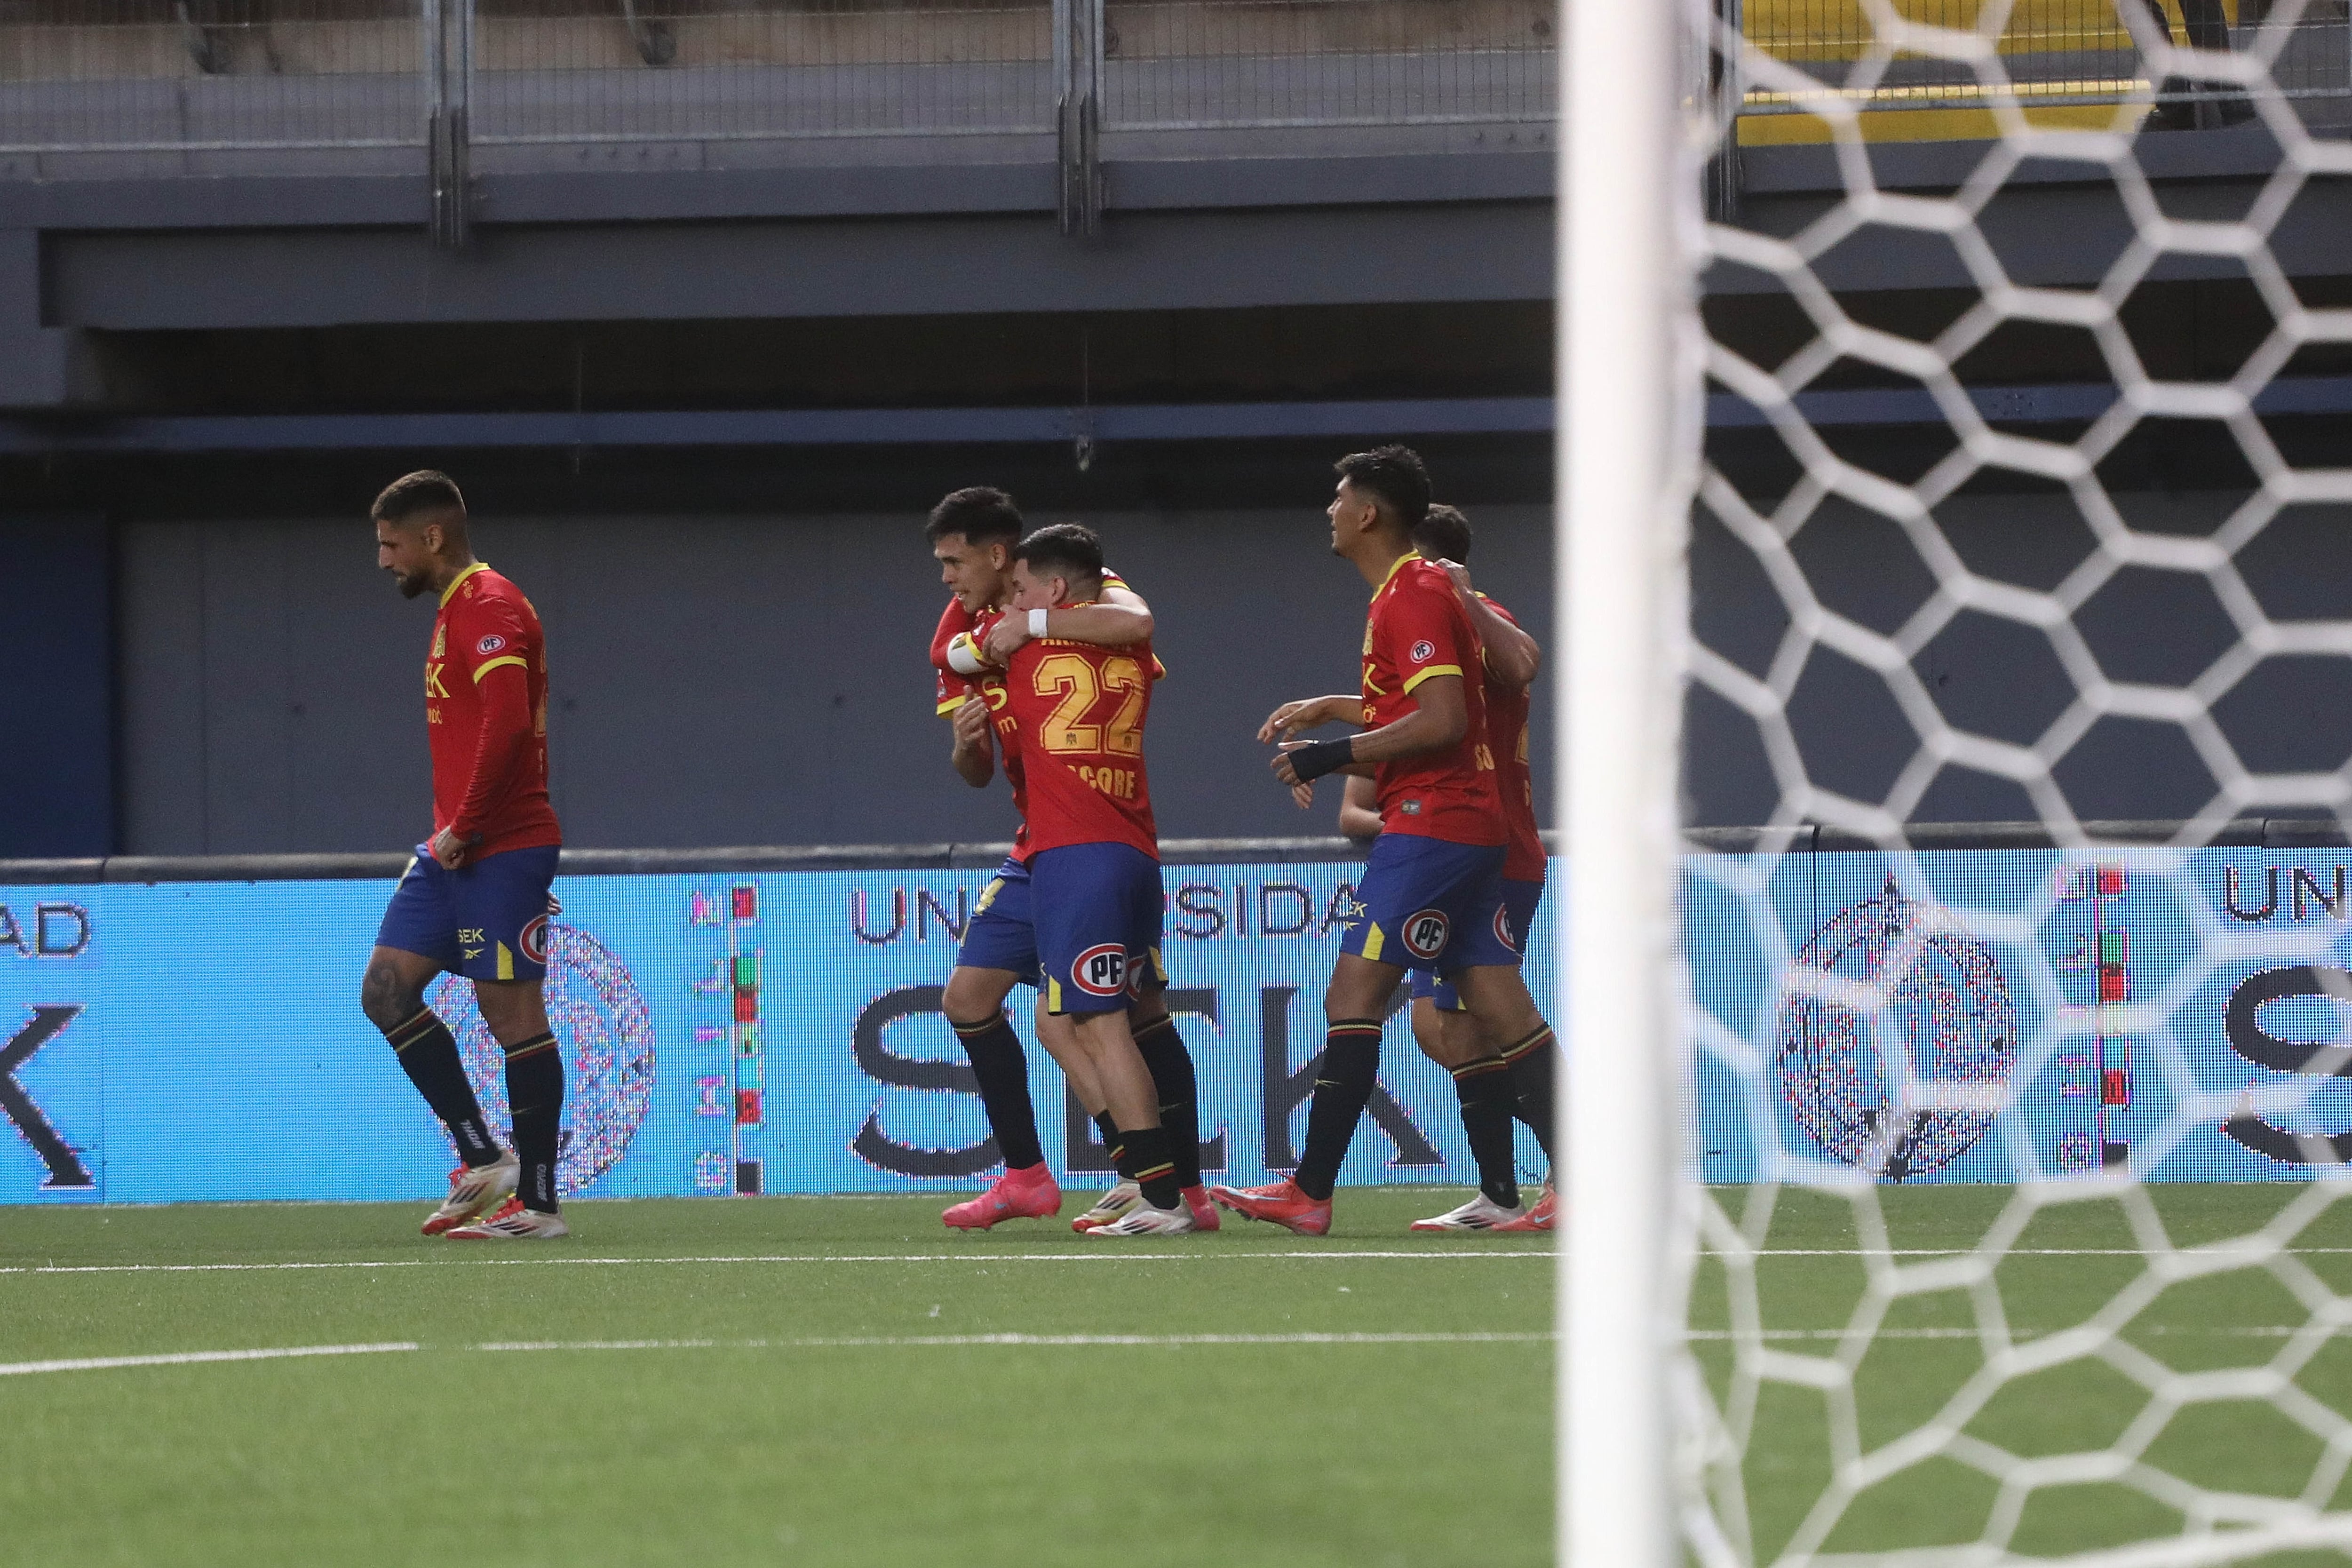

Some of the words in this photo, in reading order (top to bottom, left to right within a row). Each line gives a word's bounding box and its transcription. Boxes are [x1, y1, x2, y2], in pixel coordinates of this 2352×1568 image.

[483, 637, 497, 650] PF
[1415, 644, 1427, 658] PF
[1033, 653, 1145, 758] 22
[1414, 918, 1443, 949] PF
[1090, 954, 1124, 985] PF
